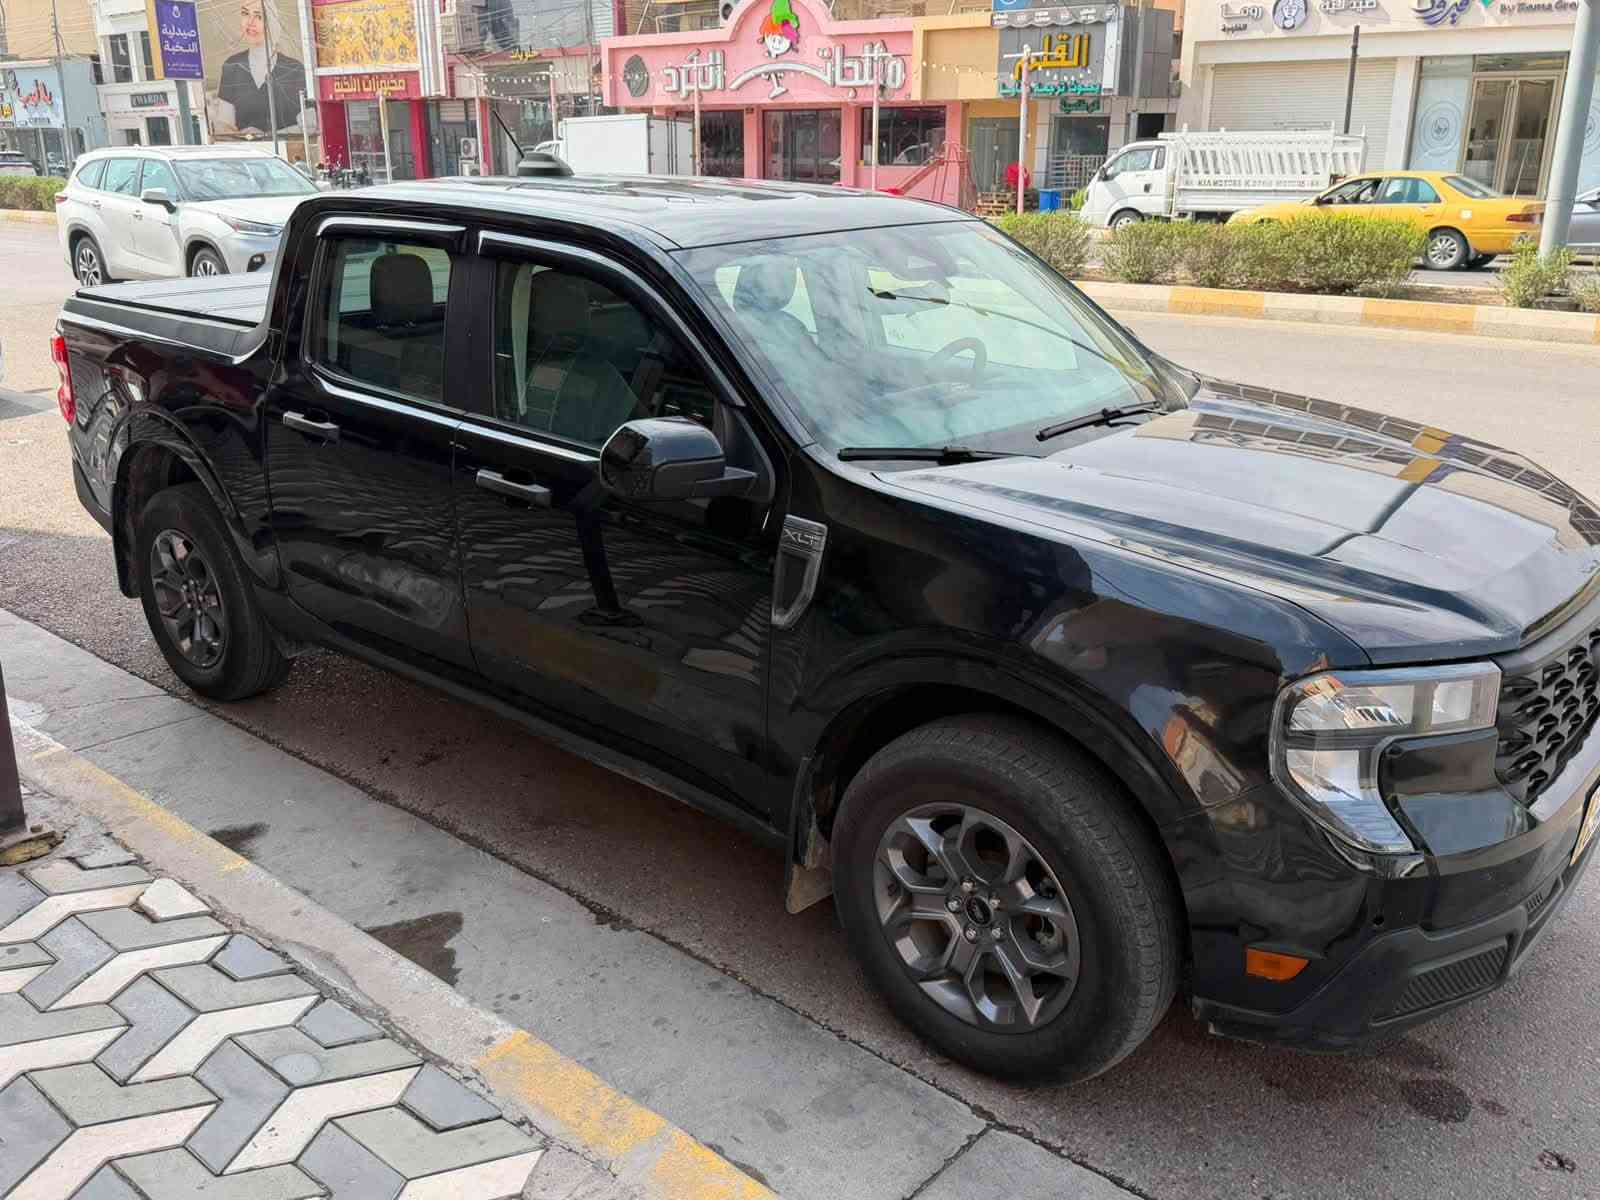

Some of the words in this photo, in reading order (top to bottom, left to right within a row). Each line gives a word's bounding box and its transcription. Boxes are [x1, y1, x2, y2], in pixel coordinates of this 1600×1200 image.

[161, 23, 197, 39] صيدلية
[1013, 31, 1089, 81] القلم
[781, 527, 822, 546] XLT
